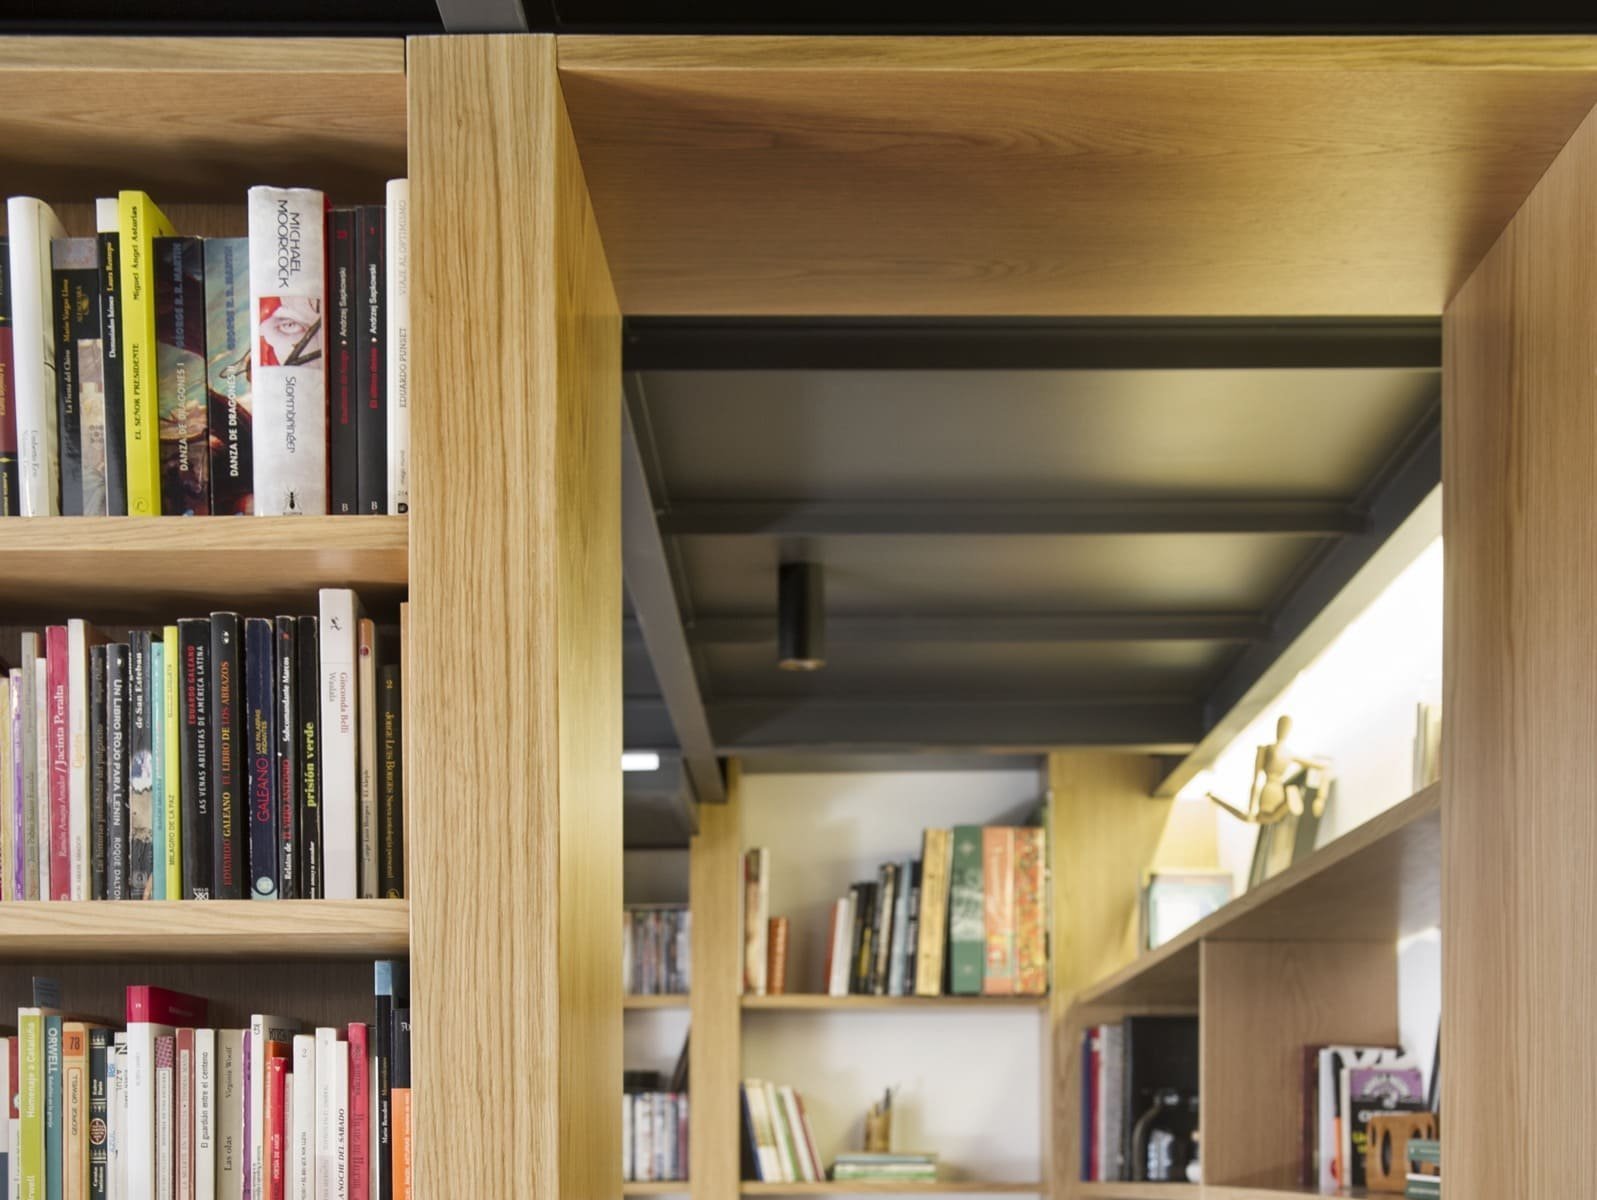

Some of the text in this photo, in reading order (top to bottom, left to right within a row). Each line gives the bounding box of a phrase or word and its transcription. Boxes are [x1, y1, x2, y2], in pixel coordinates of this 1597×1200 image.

[130, 206, 138, 241] Asturias
[278, 200, 289, 288] MOORCOCK
[290, 212, 300, 276] MICHAEL
[132, 273, 141, 300] Miguel
[339, 308, 348, 337] Andrzej
[369, 305, 378, 334] Andrzej
[131, 344, 141, 440] EL SEÑOR PRESIDENTE
[177, 369, 187, 420] DRAGONES
[178, 423, 187, 434] DE
[179, 438, 189, 471] DANZA
[133, 652, 143, 728] de San Esteban
[187, 646, 196, 725] EDUARDO GALEANO
[220, 661, 229, 705] ABRAZOS
[282, 657, 290, 742] Subcomandante Marcos
[195, 646, 207, 814] LAS VENAS ABIERTAS DE AMÉRICA LATINA
[221, 727, 230, 740] DE
[113, 679, 122, 826] UN LIBRO ROJO PARA LENIN
[221, 743, 231, 771] LIBRO
[304, 722, 316, 807] prisión verde
[256, 758, 270, 822] GALEANO
[222, 792, 231, 837] GALEANO
[223, 839, 232, 885] EDUARDO
[48, 1028, 58, 1074] ORWELL
[201, 1052, 209, 1079] centeno
[26, 1076, 37, 1118] Homenaje
[201, 1090, 209, 1108] entre
[225, 1069, 234, 1098] Virginia
[200, 1110, 211, 1140] guardián
[224, 1136, 232, 1171] Las olas
